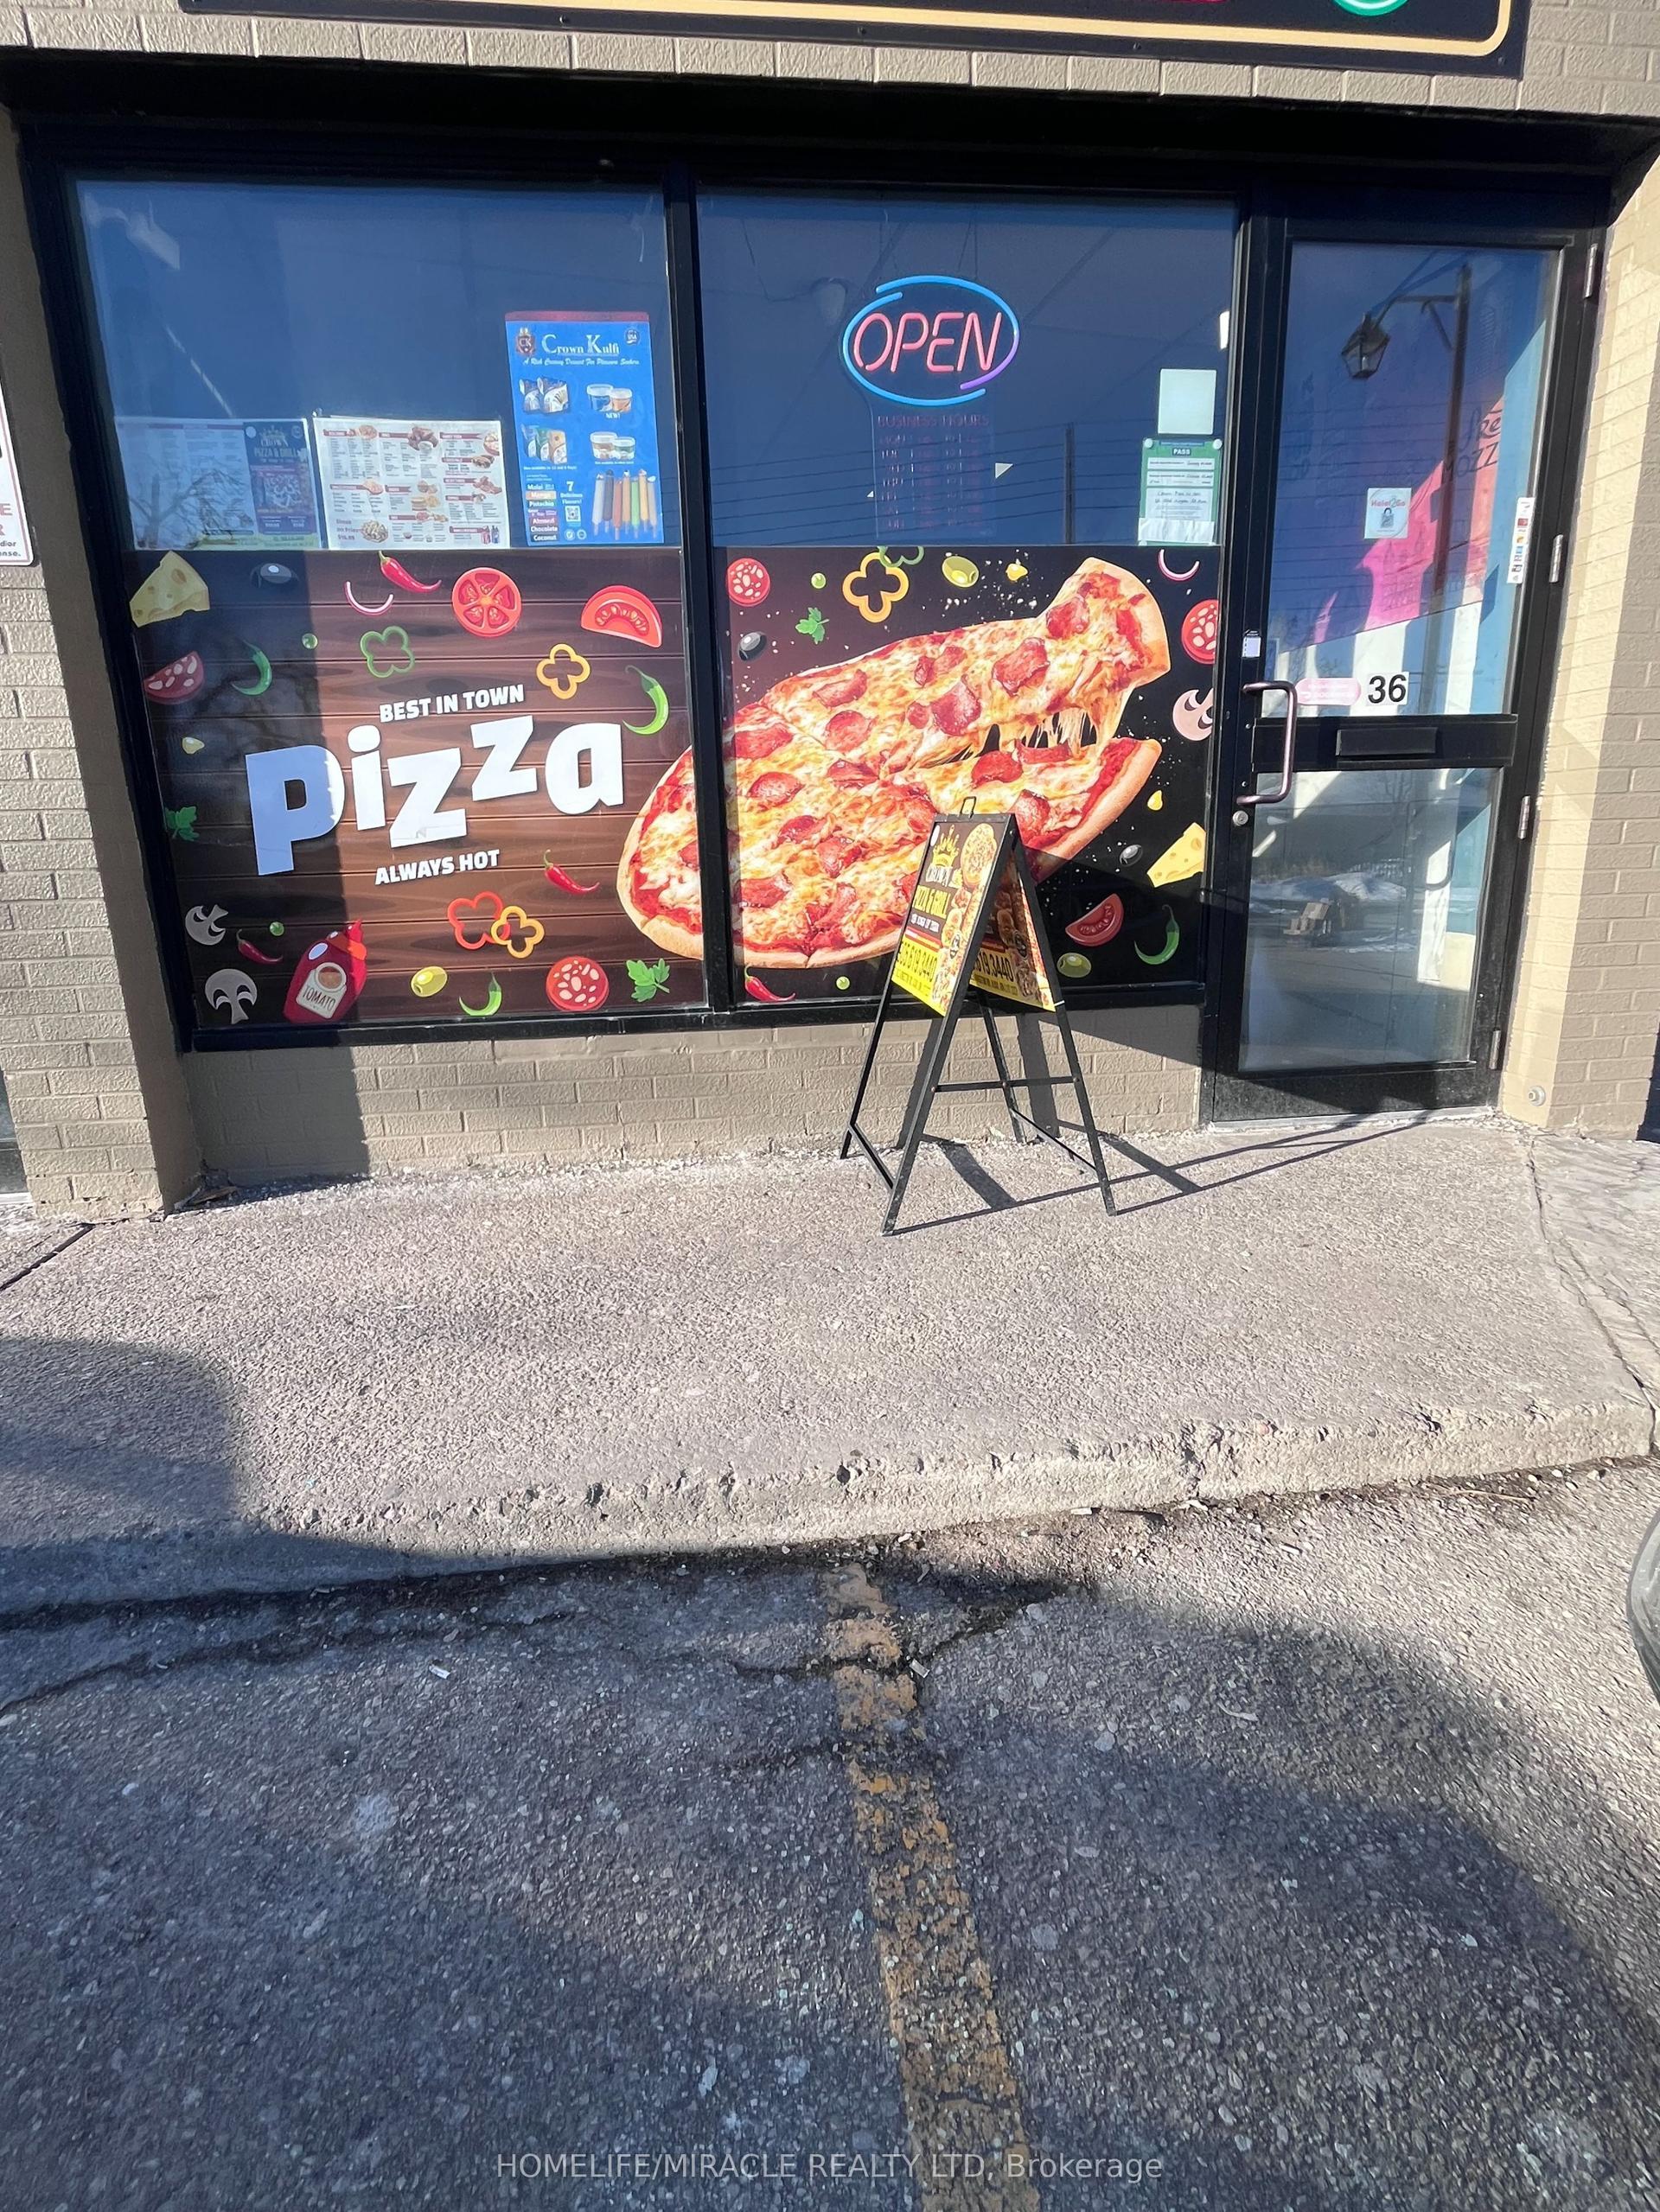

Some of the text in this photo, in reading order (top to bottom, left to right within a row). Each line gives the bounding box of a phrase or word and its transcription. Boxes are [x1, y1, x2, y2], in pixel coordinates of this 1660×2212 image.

[541, 334, 620, 354] Crown Kulfi
[852, 312, 1002, 373] OPEN
[878, 414, 990, 428] BUSINESS HOURS
[566, 481, 574, 492] 7
[379, 684, 525, 723] BEST IN TOWN
[1368, 673, 1408, 704] 36
[246, 715, 624, 877] pizza
[374, 849, 500, 885] ALWAYS HOT
[303, 985, 336, 1011] TOMATO
